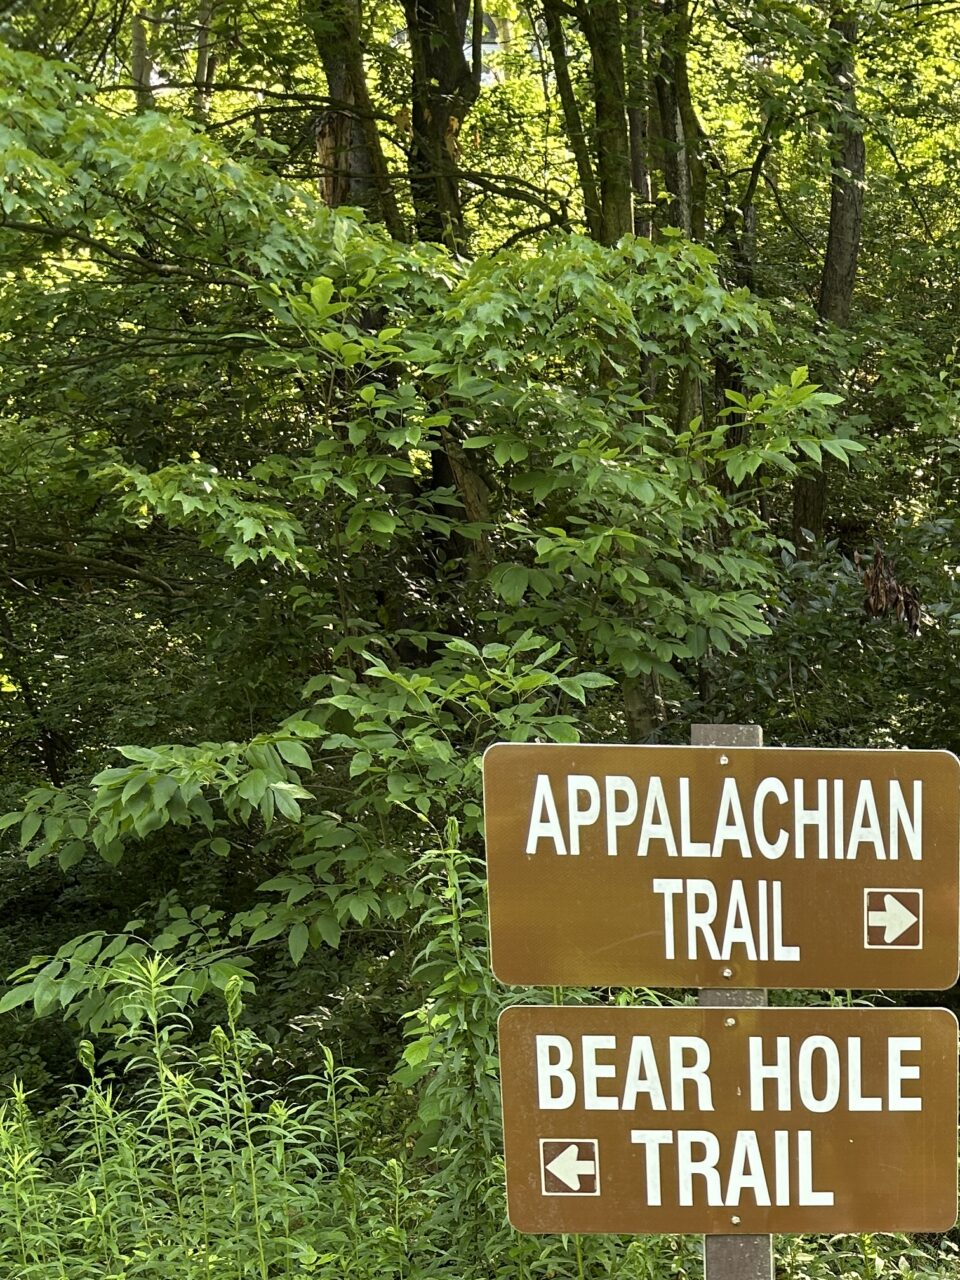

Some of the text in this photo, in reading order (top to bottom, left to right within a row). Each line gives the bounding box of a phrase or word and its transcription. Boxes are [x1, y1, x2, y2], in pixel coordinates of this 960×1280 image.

[525, 774, 923, 861] APPALACHIAN
[652, 878, 801, 962] TRAIL
[535, 1034, 922, 1113] BEAR HOLE
[630, 1129, 834, 1207] TRAIL
